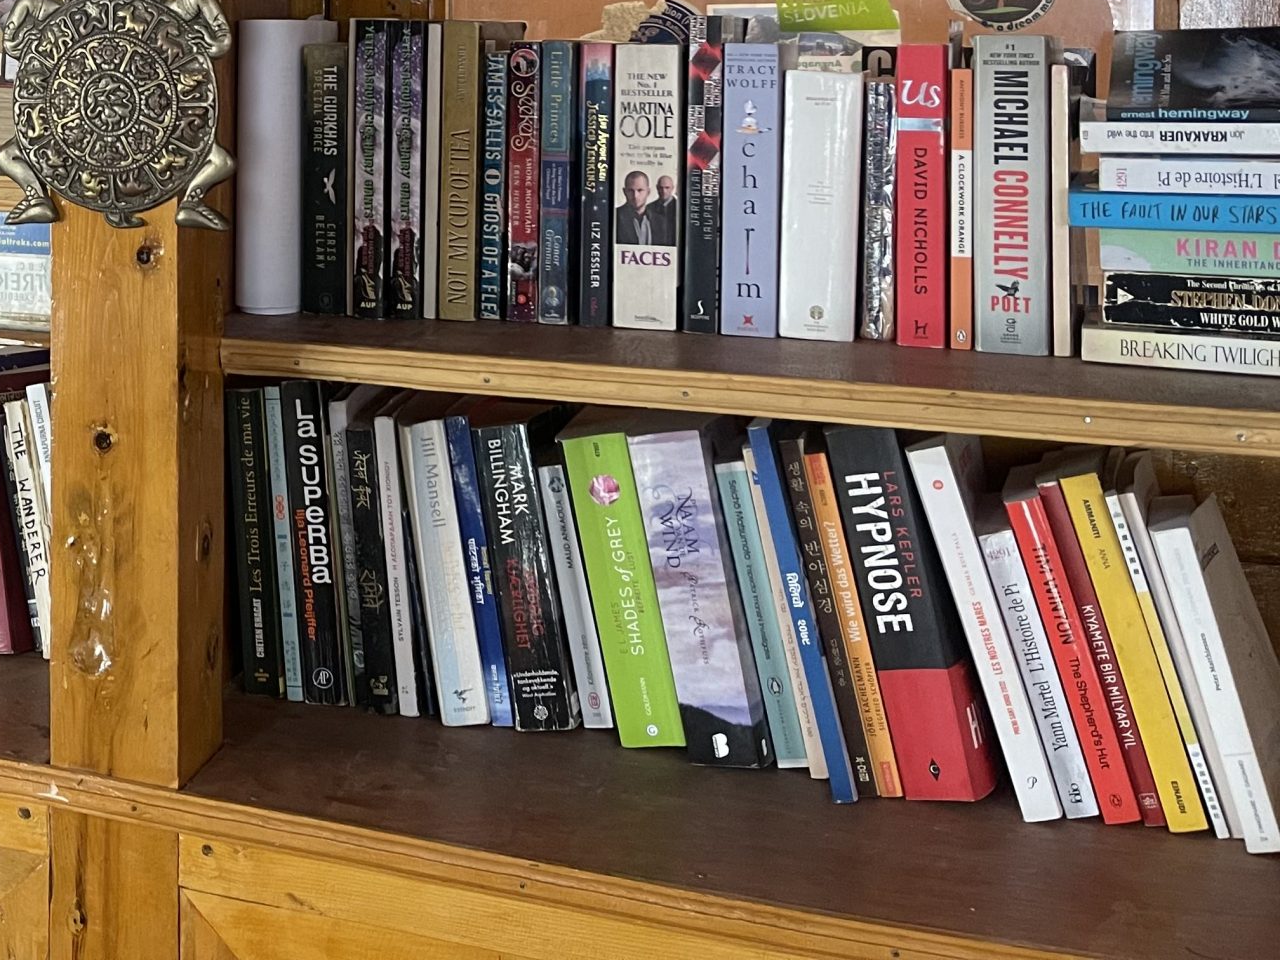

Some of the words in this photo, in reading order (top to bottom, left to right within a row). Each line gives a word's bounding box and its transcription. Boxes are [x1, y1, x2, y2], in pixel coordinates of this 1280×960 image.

[783, 1, 870, 23] SLOVENIA
[1005, 43, 1016, 51] #1
[323, 65, 337, 93] THE
[487, 52, 504, 102] JAMES
[550, 49, 563, 88] Little
[627, 72, 648, 81] THE
[650, 72, 668, 81] NEW
[727, 65, 777, 75] TRACY
[727, 79, 777, 89] WOLFF
[313, 68, 322, 115] SPECIAL
[901, 79, 942, 109] Us
[323, 95, 338, 156] GURKHAS
[511, 81, 538, 152] Seekers
[550, 93, 563, 144] Princes
[620, 102, 674, 116] MARTINA
[993, 71, 1029, 165] MICHAEL
[1120, 111, 1155, 119] ernest
[1158, 108, 1250, 120] hemingway
[313, 119, 322, 153] FORCE
[485, 108, 503, 160] SALLIS
[620, 117, 674, 138] COLE
[1107, 130, 1123, 139] wild
[1125, 130, 1138, 139] the
[1140, 130, 1154, 139] Into
[1159, 131, 1227, 141] KRAKAUER
[1229, 131, 1246, 140] Jon
[450, 128, 471, 164] TEA
[449, 169, 470, 190] OF
[914, 147, 928, 200] DAVID
[1157, 170, 1171, 186] Pi
[1175, 172, 1192, 186] de
[1195, 171, 1263, 189] L'Histoire
[448, 193, 470, 227] CUP
[483, 192, 500, 240] GHOST
[993, 170, 1029, 279] CONNELLY
[1080, 201, 1111, 218] THE
[1121, 202, 1163, 220] FAULT
[1171, 205, 1188, 222] IN
[1192, 205, 1220, 223] OUR
[1228, 205, 1277, 224] STARS
[326, 222, 336, 261] CHRIS
[448, 228, 470, 260] MY
[591, 221, 601, 239] LIZ
[482, 245, 498, 265] OF
[545, 228, 554, 271] Grennan
[552, 234, 561, 266] Conor
[590, 243, 600, 288] KESSLER
[621, 251, 671, 266] FACES
[914, 208, 928, 295] NICHOLLS
[1176, 238, 1258, 259] KIRAN
[447, 266, 470, 304] NOT
[481, 268, 497, 281] A
[480, 284, 497, 319] FLEA
[991, 297, 1031, 314] POET
[1200, 312, 1236, 326] WHITE
[1238, 314, 1269, 328] GOLD
[421, 436, 433, 459] Jill
[427, 463, 446, 529] Mansell
[488, 438, 516, 545] BILLINGHAM
[507, 461, 529, 516] MARK
[9, 422, 27, 460] THE
[18, 478, 47, 586] WANDERER
[296, 508, 305, 528] Ilja
[560, 499, 572, 543] ANKAOUA
[677, 487, 700, 555] NAAM
[606, 516, 627, 562] GREY
[657, 511, 681, 569] WIND
[823, 521, 844, 566] Wetter?
[882, 471, 904, 518] LARS
[895, 526, 923, 598] KEPLER
[1082, 499, 1101, 539] AMMANITI
[1097, 548, 1111, 570] ANNA
[298, 530, 312, 583] Leonard
[565, 547, 574, 569] MAUD
[845, 472, 913, 634] HYPNOSE
[618, 565, 634, 584] of
[804, 540, 833, 614] 반야심경
[835, 566, 850, 588] das
[1004, 583, 1020, 595] Pi
[303, 583, 316, 640] Pfeijffer
[839, 590, 855, 618] wird
[972, 601, 989, 627] MARES
[1012, 593, 1026, 610] de
[621, 586, 644, 655] SHADES
[849, 621, 862, 643] Wie
[982, 624, 1000, 659] NOSTRES
[1017, 608, 1046, 674] L'Histoire
[992, 658, 1003, 676] LES
[1068, 657, 1082, 675] The
[853, 657, 874, 719] KACHELMANN
[1039, 680, 1060, 717] Martel
[1073, 676, 1103, 745] Shepherd's
[866, 720, 877, 737] JÖRG
[1050, 718, 1069, 752] Yann
[1095, 746, 1110, 769] Hut
[1170, 780, 1186, 814] EINAUDI
